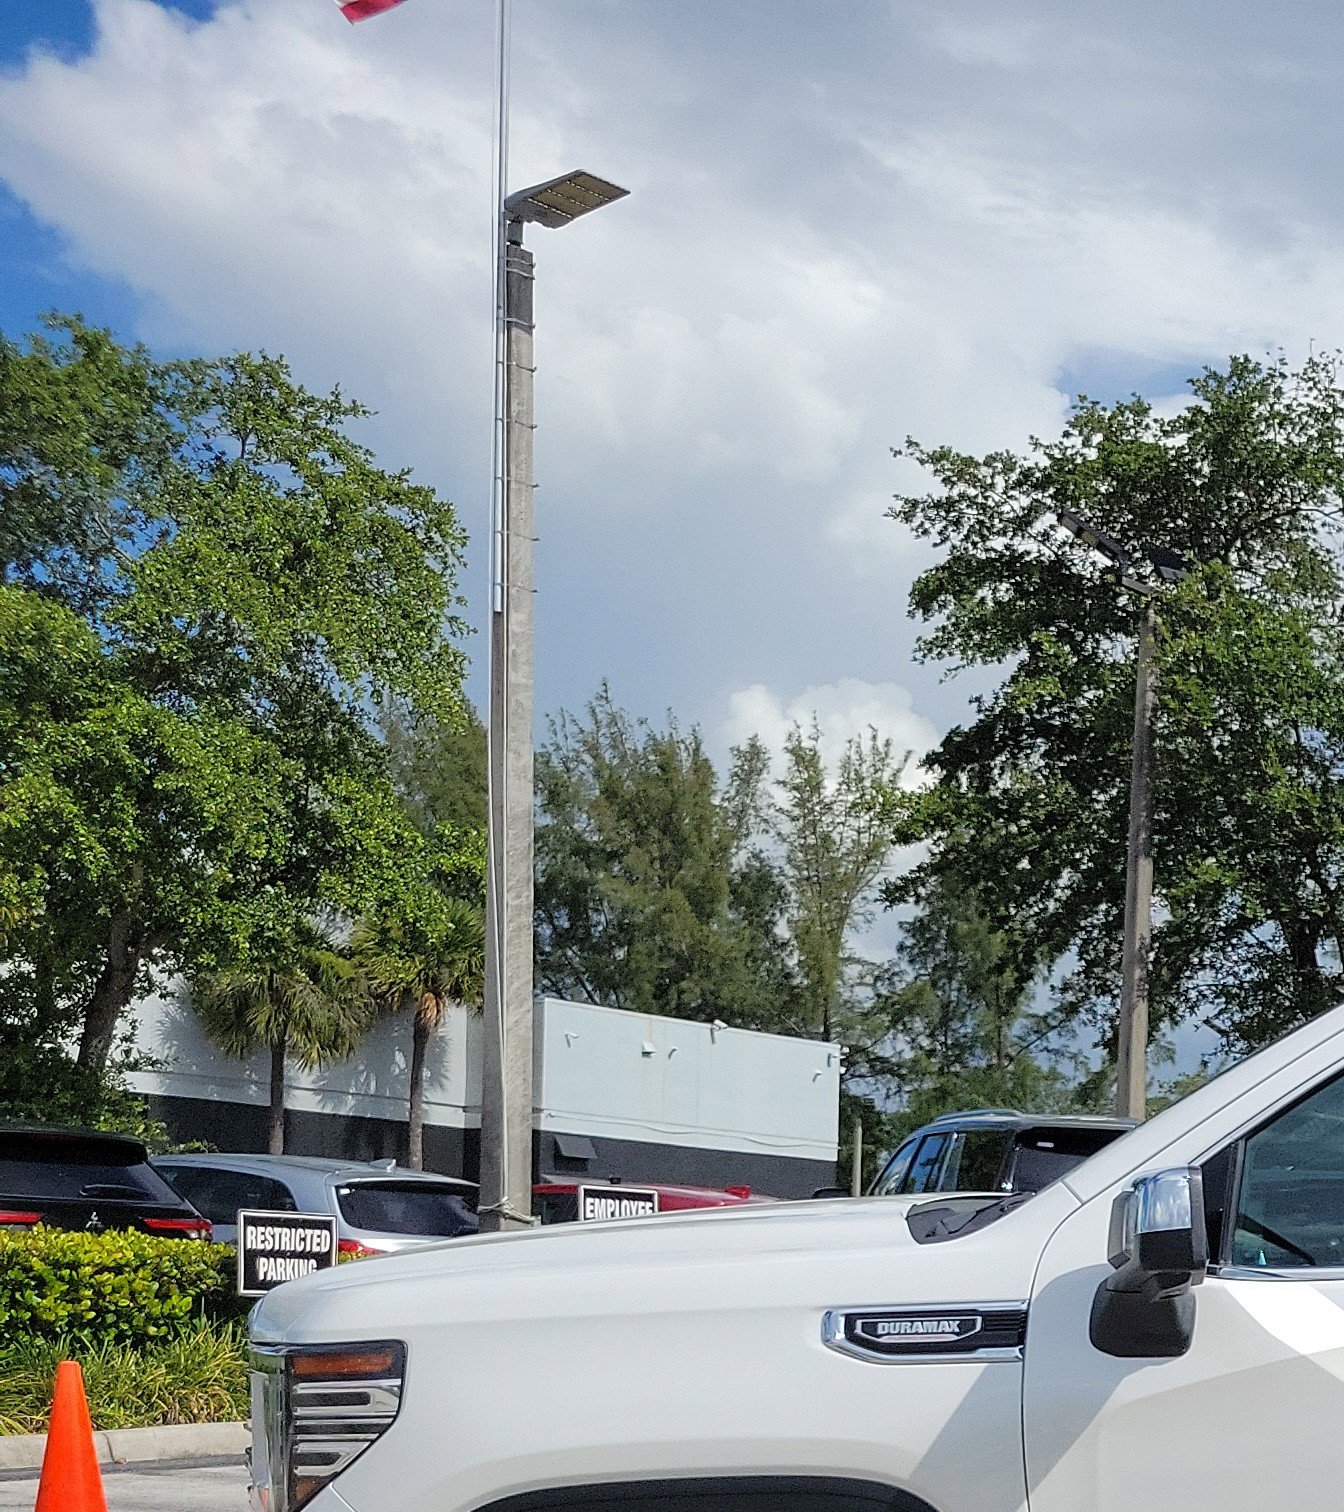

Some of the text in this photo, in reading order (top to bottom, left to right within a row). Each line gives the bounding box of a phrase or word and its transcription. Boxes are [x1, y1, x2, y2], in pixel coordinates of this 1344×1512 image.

[585, 1197, 654, 1219] EMPLOYEE
[246, 1225, 331, 1253] RESTRICTED
[877, 1320, 961, 1335] DURAMAX
